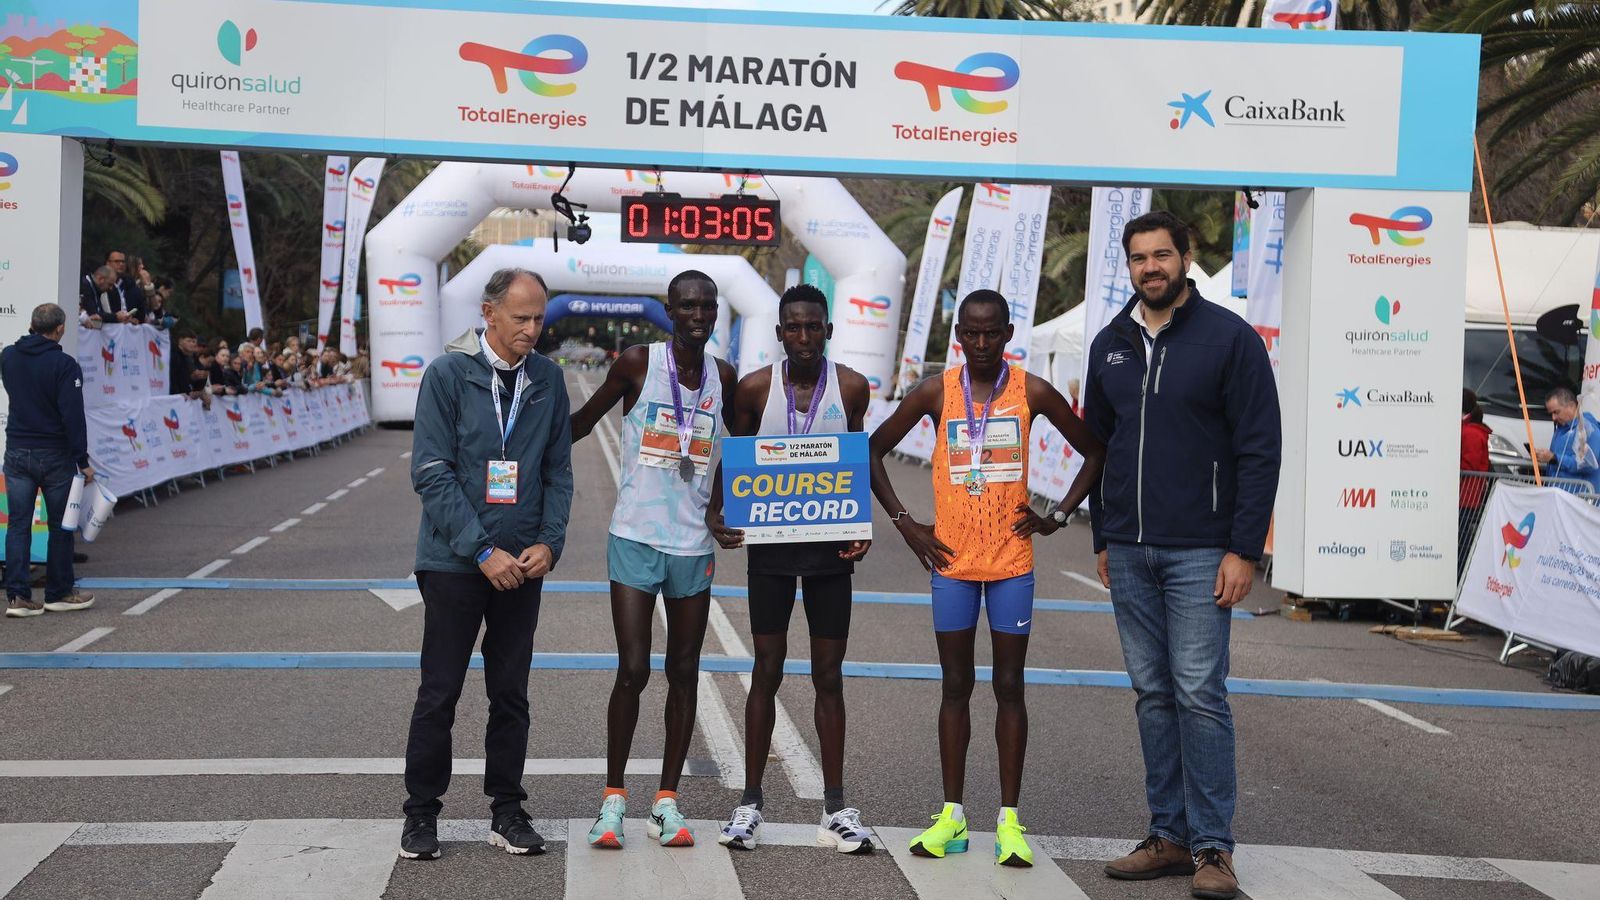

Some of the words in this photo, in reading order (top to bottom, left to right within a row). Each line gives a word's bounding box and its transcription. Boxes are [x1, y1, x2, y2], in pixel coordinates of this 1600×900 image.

[626, 51, 678, 82] 1/2
[687, 52, 857, 89] MARATÓN
[171, 73, 301, 95] quirónsalud
[182, 99, 245, 113] Healthcare
[248, 102, 291, 116] Partner
[625, 97, 670, 126] DE
[680, 94, 828, 133] MÁLAGA
[1224, 95, 1346, 122] CaixaBank
[458, 106, 587, 130] TotalEnergies
[892, 124, 1018, 147] TotalEnergies
[511, 180, 570, 193] TotalEnergis
[1348, 253, 1432, 267] TotalEnergies
[591, 302, 644, 313] HYUNDAI
[1351, 347, 1392, 356] Healthcare
[1394, 348, 1422, 356] Partner
[1367, 388, 1434, 403] CaixaBank
[800, 441, 832, 449] MARATÓN
[1338, 439, 1383, 457] UAX
[731, 471, 854, 498] COURSE
[1391, 488, 1428, 497] metro
[749, 499, 859, 523] RECORD
[1390, 499, 1429, 511] Málaga
[1318, 541, 1366, 557] málaga
[1409, 544, 1433, 552] Ciudad
